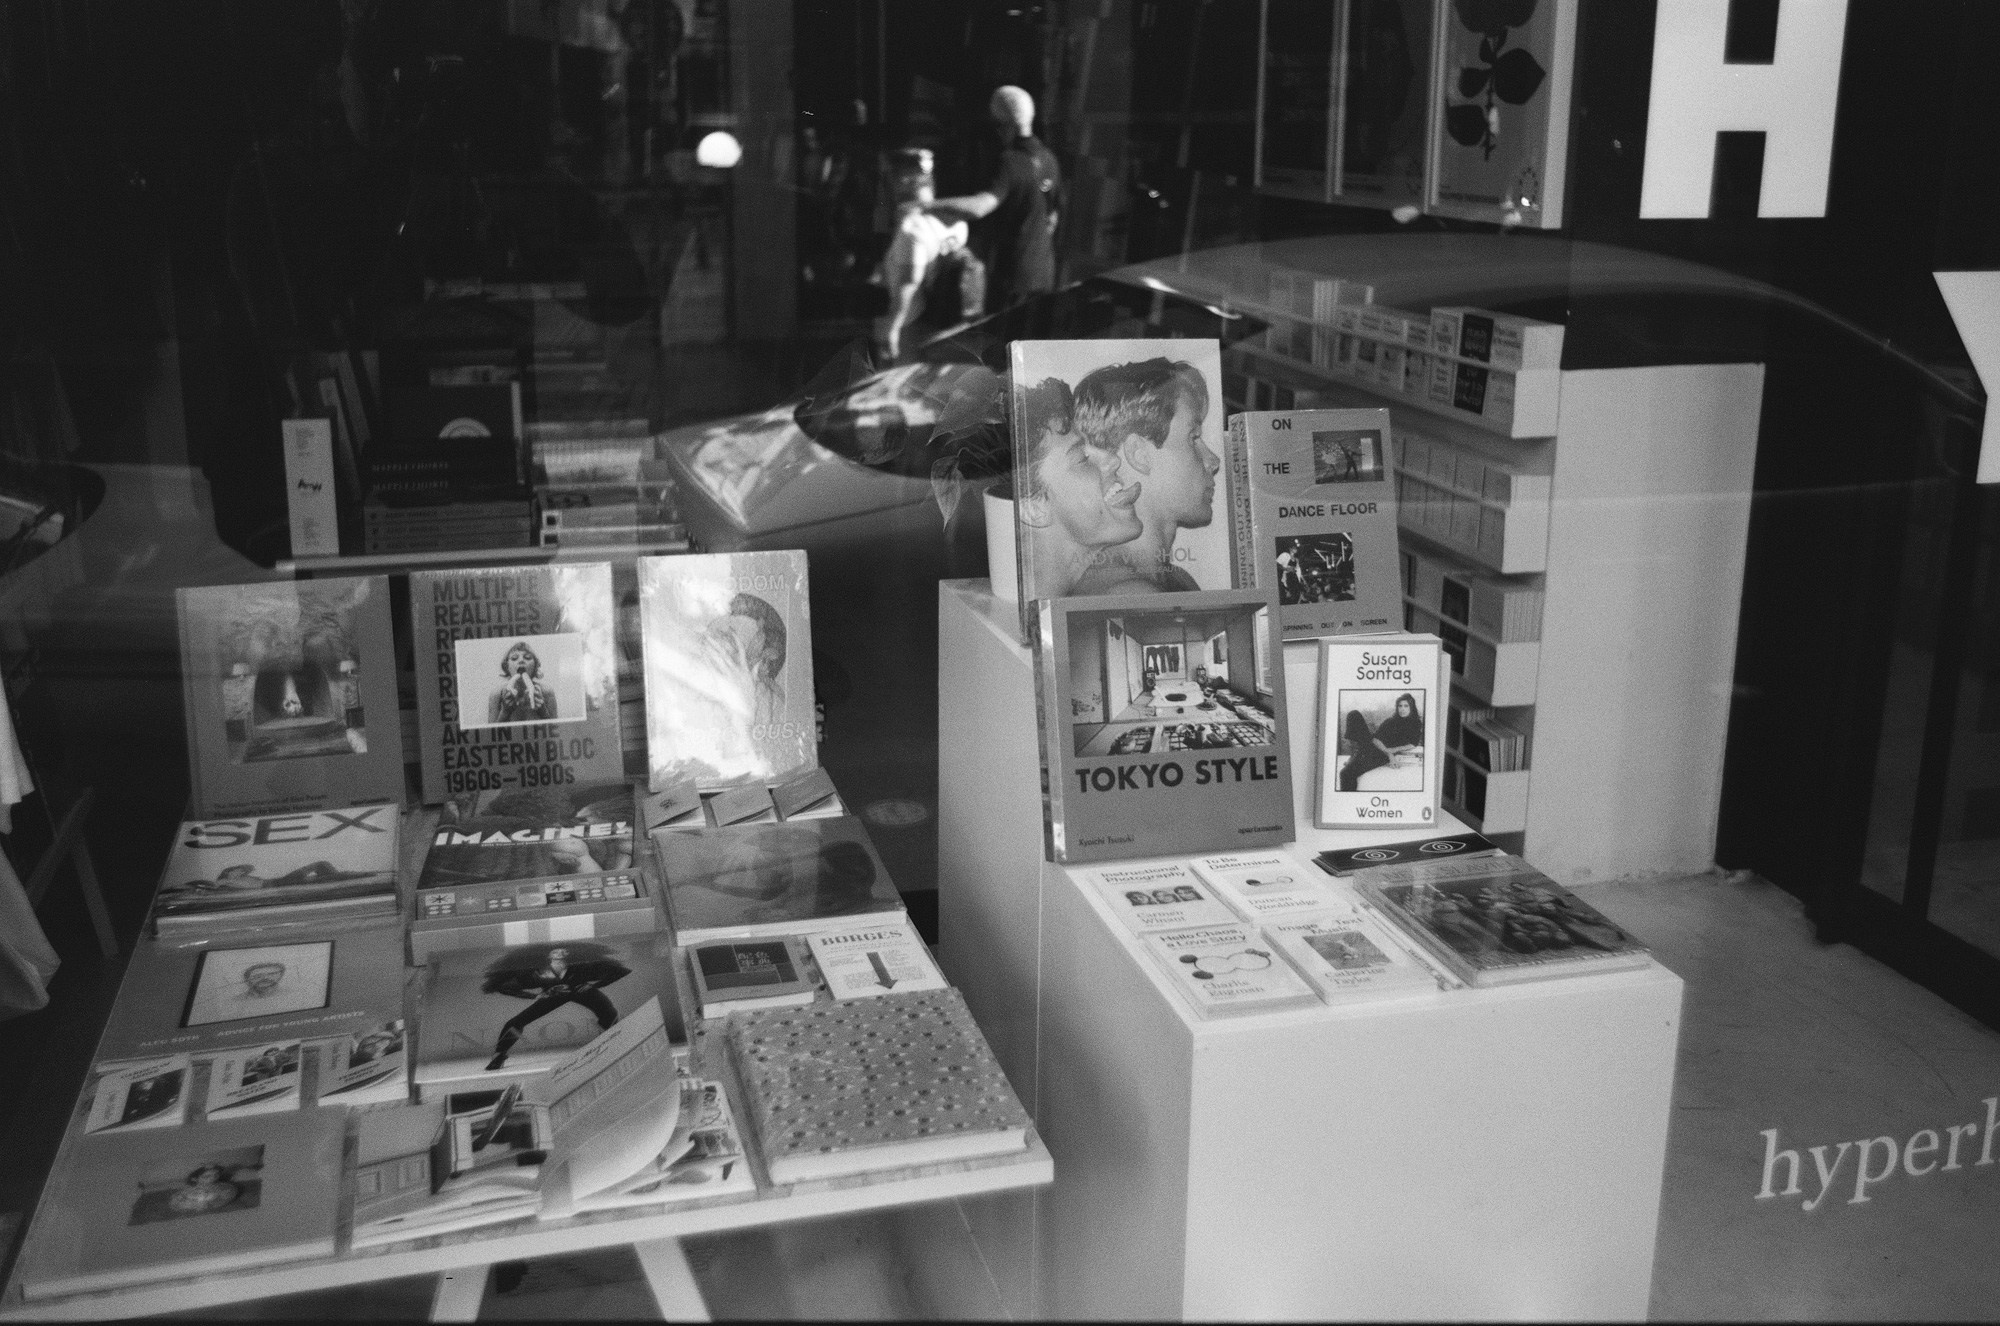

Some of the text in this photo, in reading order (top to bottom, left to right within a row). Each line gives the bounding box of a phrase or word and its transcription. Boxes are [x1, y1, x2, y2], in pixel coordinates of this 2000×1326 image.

[1271, 418, 1292, 431] ON
[1263, 462, 1290, 475] THE
[1278, 502, 1378, 519] DANCE FLOOR
[433, 576, 539, 602] MULTIPLE
[435, 600, 541, 627] REALITIES
[1362, 651, 1408, 666] Susan
[1356, 666, 1412, 685] Sontag
[442, 723, 560, 746] ART IN THE
[443, 737, 595, 770] EASTERN BLOC
[1075, 756, 1279, 793] TOKYO STYLE
[1370, 796, 1389, 807] On
[1356, 807, 1403, 818] Women
[184, 808, 387, 848] SEX
[1079, 834, 1135, 847] Kyoichi Tsuzuki
[1101, 865, 1179, 878] Instructional
[1207, 859, 1281, 870] Determined
[1105, 871, 1187, 884] Photography
[1277, 923, 1319, 933] Image
[821, 931, 903, 946] BORGES
[1159, 934, 1195, 942] Hello
[1176, 938, 1208, 946] Love
[1209, 934, 1247, 944] Story
[217, 1026, 255, 1037] ADVICE
[258, 1022, 280, 1031] FOR
[283, 1017, 320, 1027] YOUNG
[322, 1010, 365, 1021] ARTISTS
